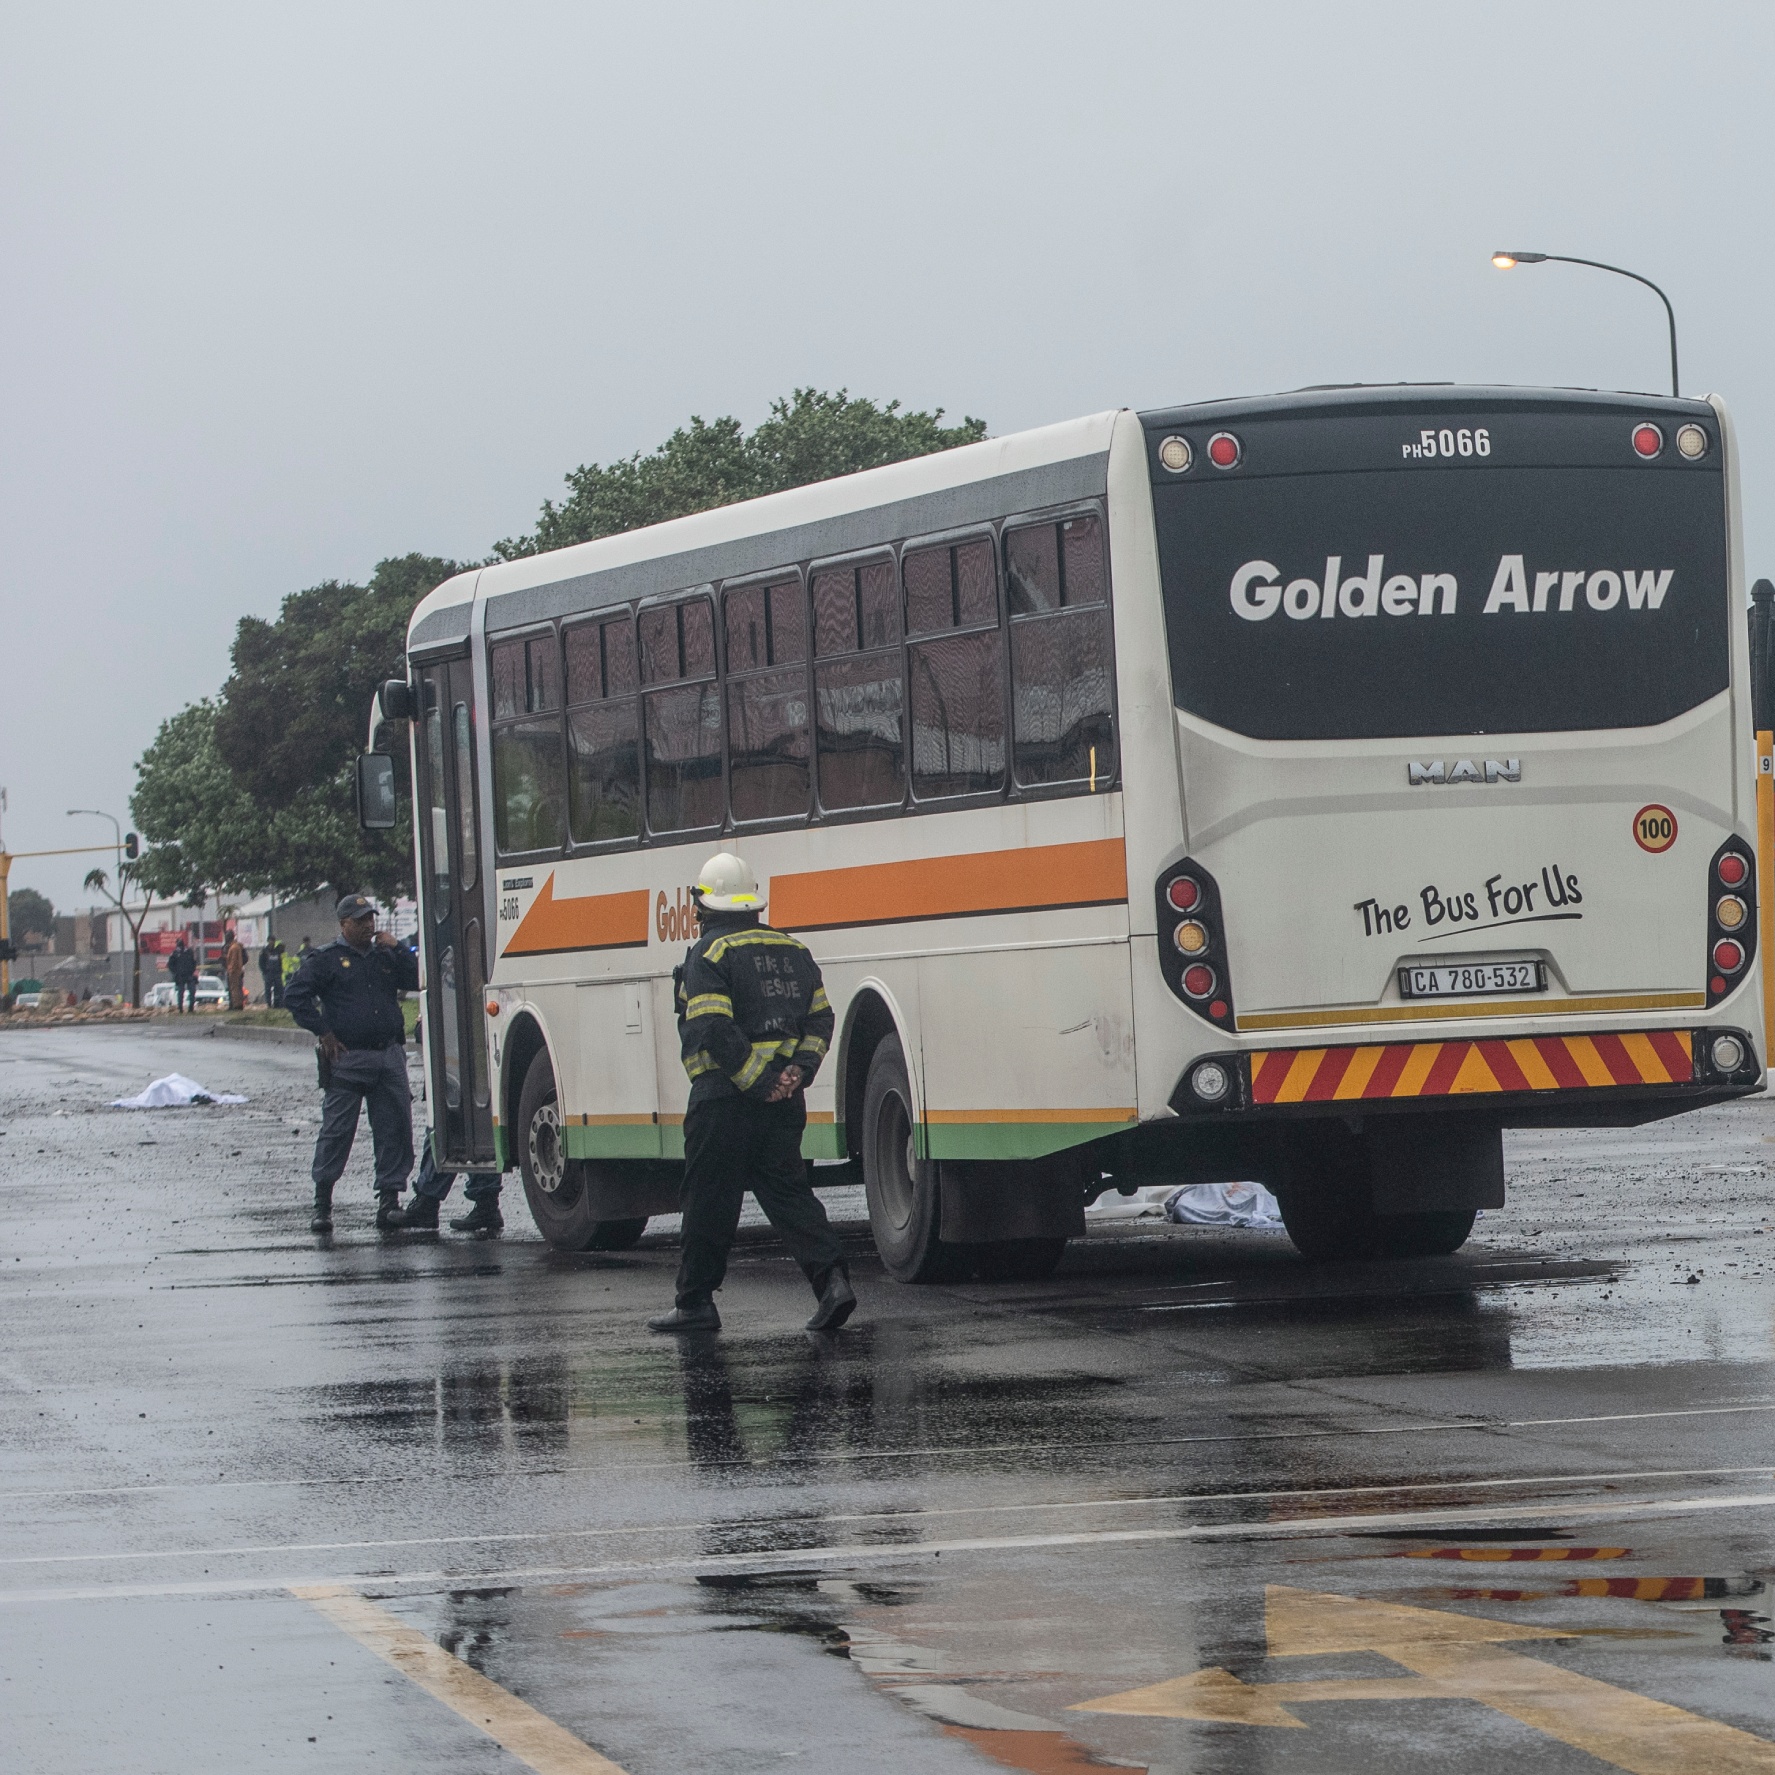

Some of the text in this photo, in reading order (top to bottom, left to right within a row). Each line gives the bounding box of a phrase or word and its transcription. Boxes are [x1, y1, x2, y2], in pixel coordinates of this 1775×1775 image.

[1229, 554, 1675, 621] Golden Arrow
[1407, 759, 1521, 785] MAN
[1763, 758, 1770, 771] 9
[1638, 817, 1672, 839] 100
[1353, 864, 1583, 936] The Bus For Us
[656, 886, 702, 942] Golde
[1414, 966, 1531, 992] CA 780-532
